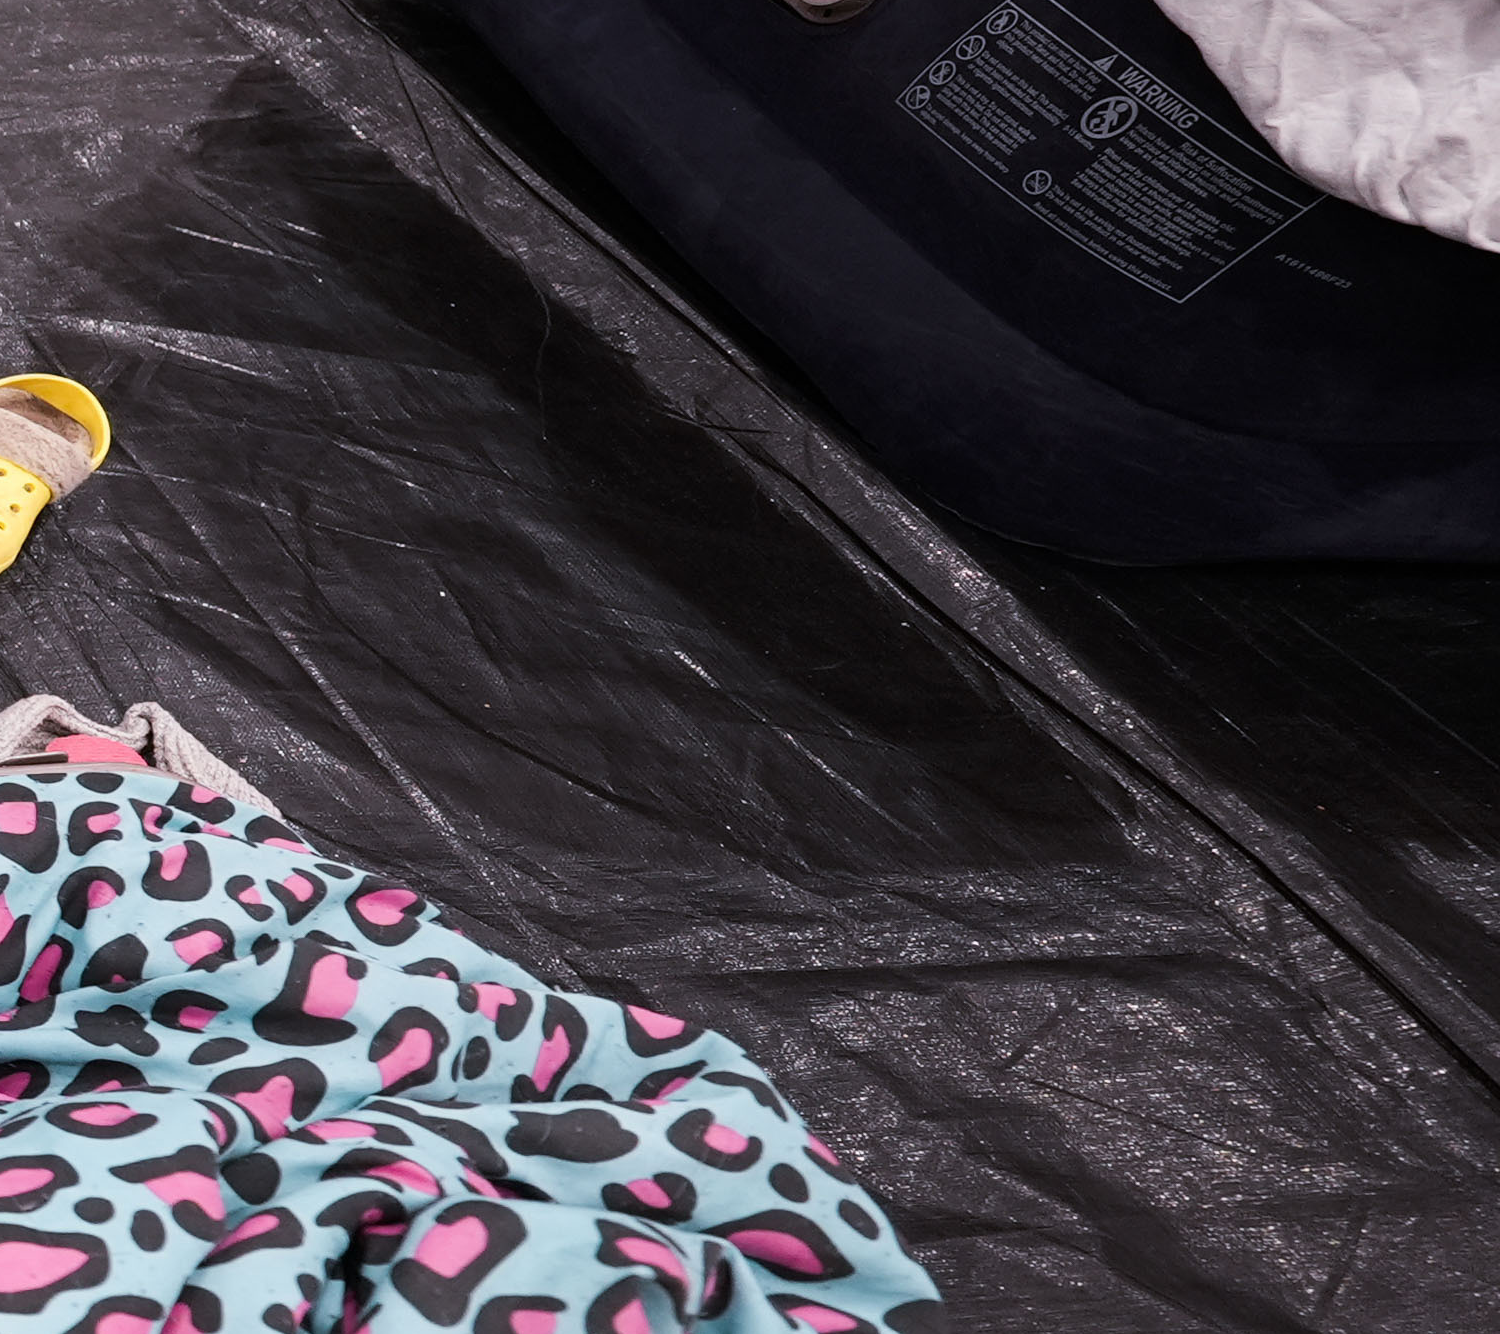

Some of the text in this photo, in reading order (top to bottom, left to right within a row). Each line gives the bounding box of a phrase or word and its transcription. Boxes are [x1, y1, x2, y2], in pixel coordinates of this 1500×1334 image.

[1114, 64, 1202, 131] WARNING
[1178, 140, 1255, 193] Risk of Suffocation
